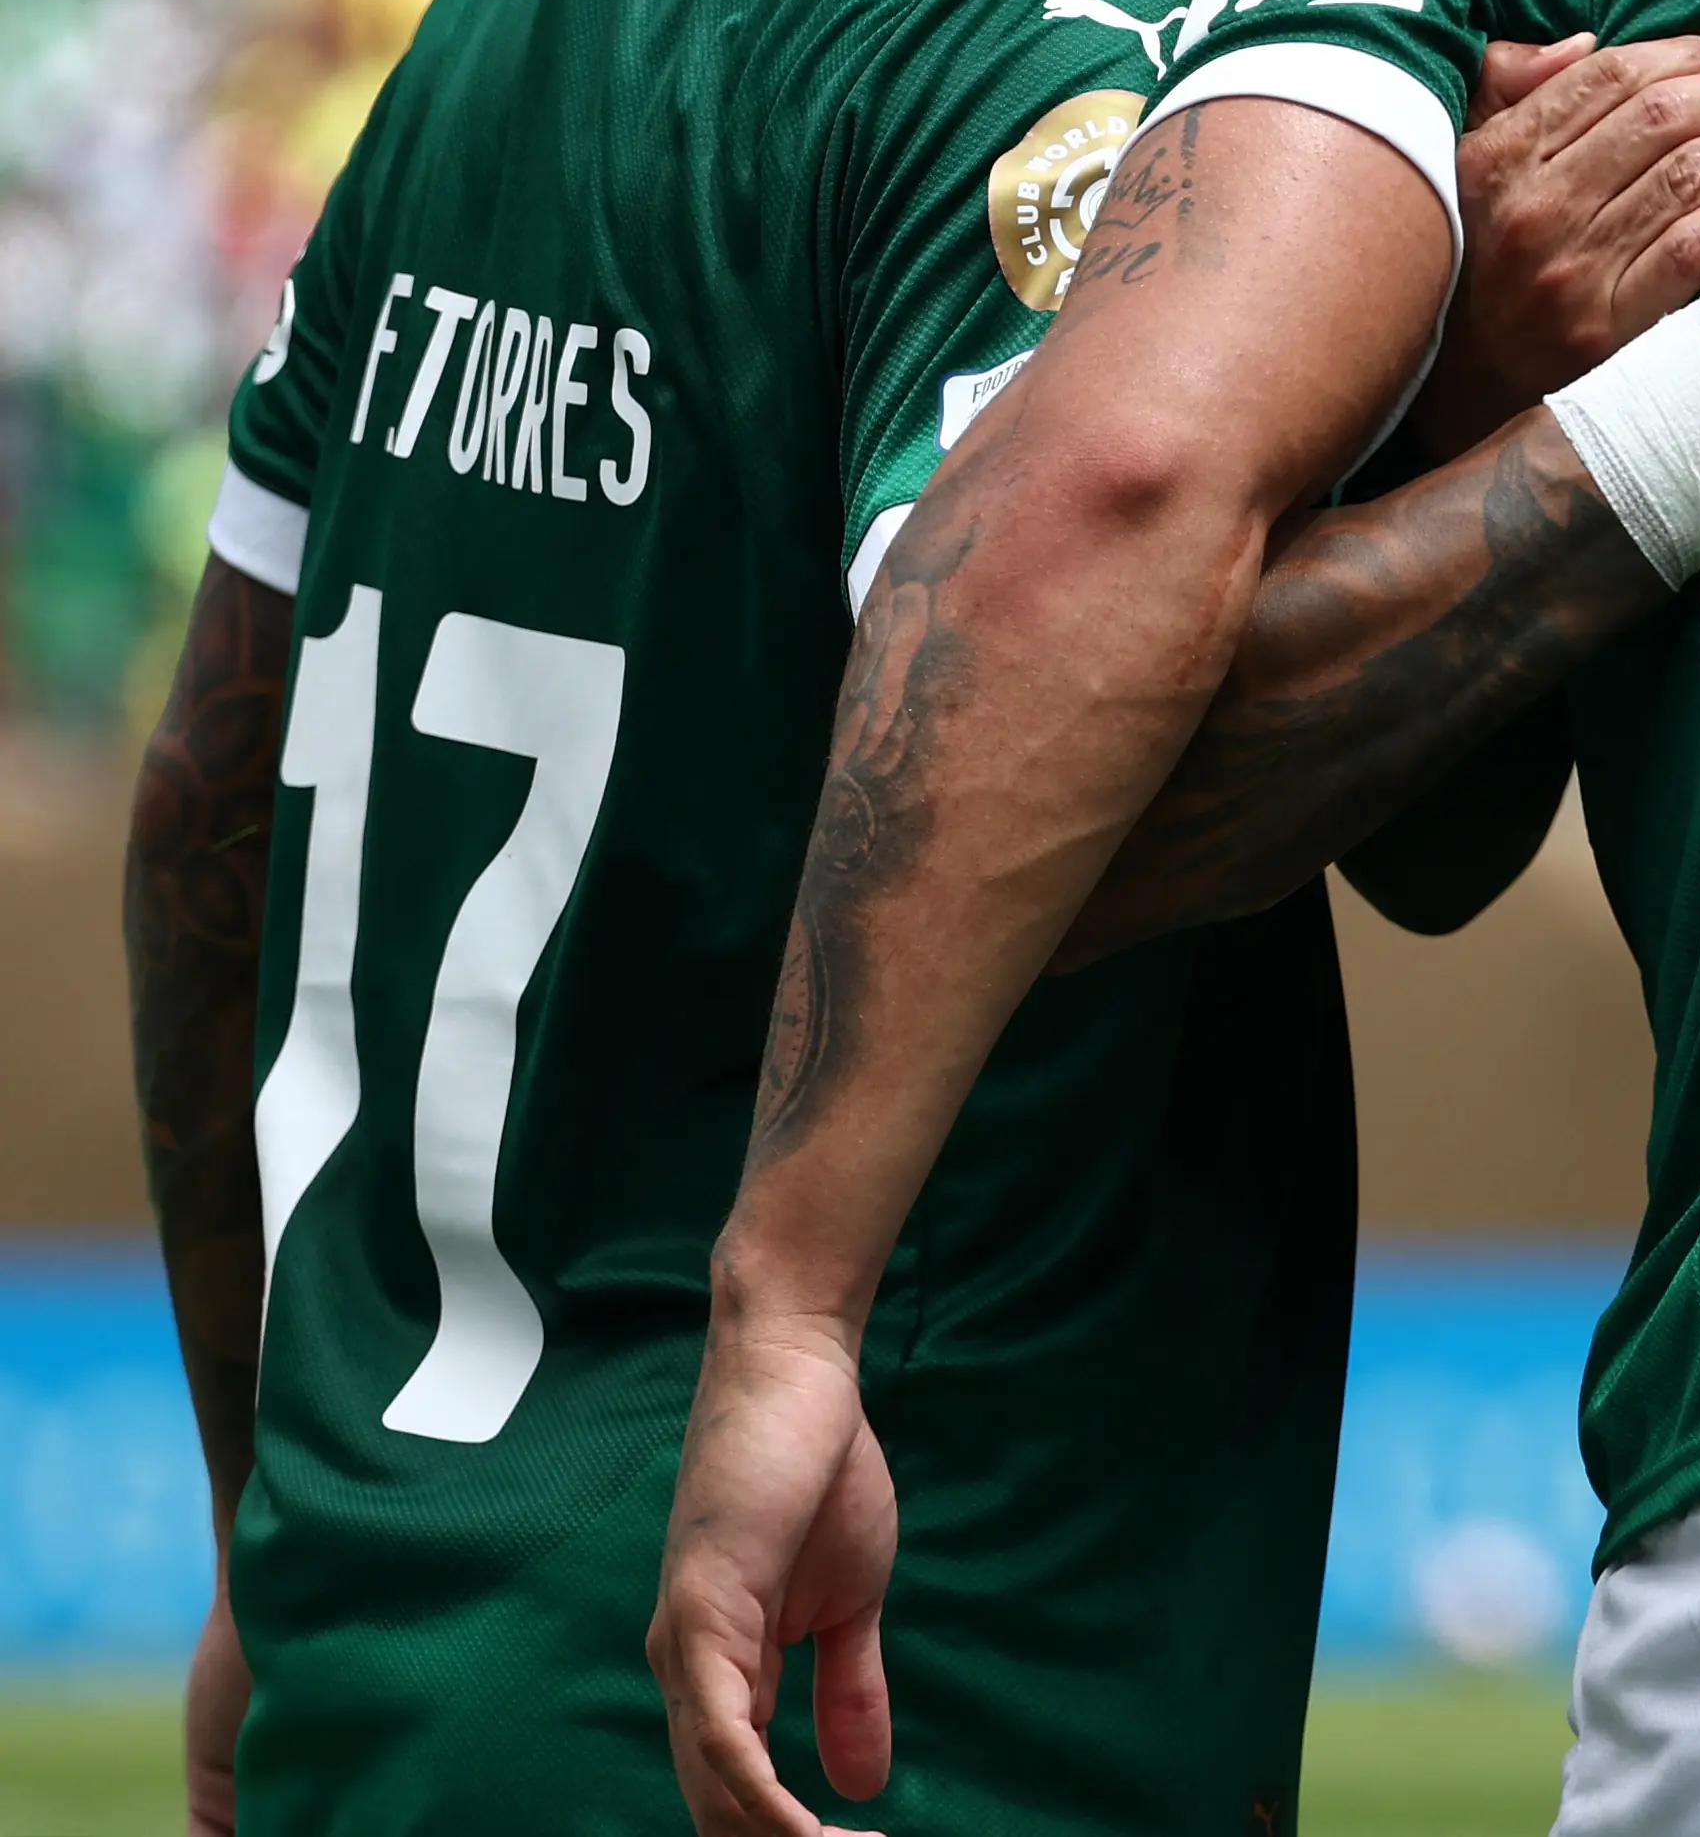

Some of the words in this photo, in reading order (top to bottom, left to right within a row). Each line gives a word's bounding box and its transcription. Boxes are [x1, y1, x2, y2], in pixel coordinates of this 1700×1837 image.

[1025, 115, 1130, 173] WORLD
[1016, 181, 1049, 267] CLUB
[254, 583, 626, 1444] 17
